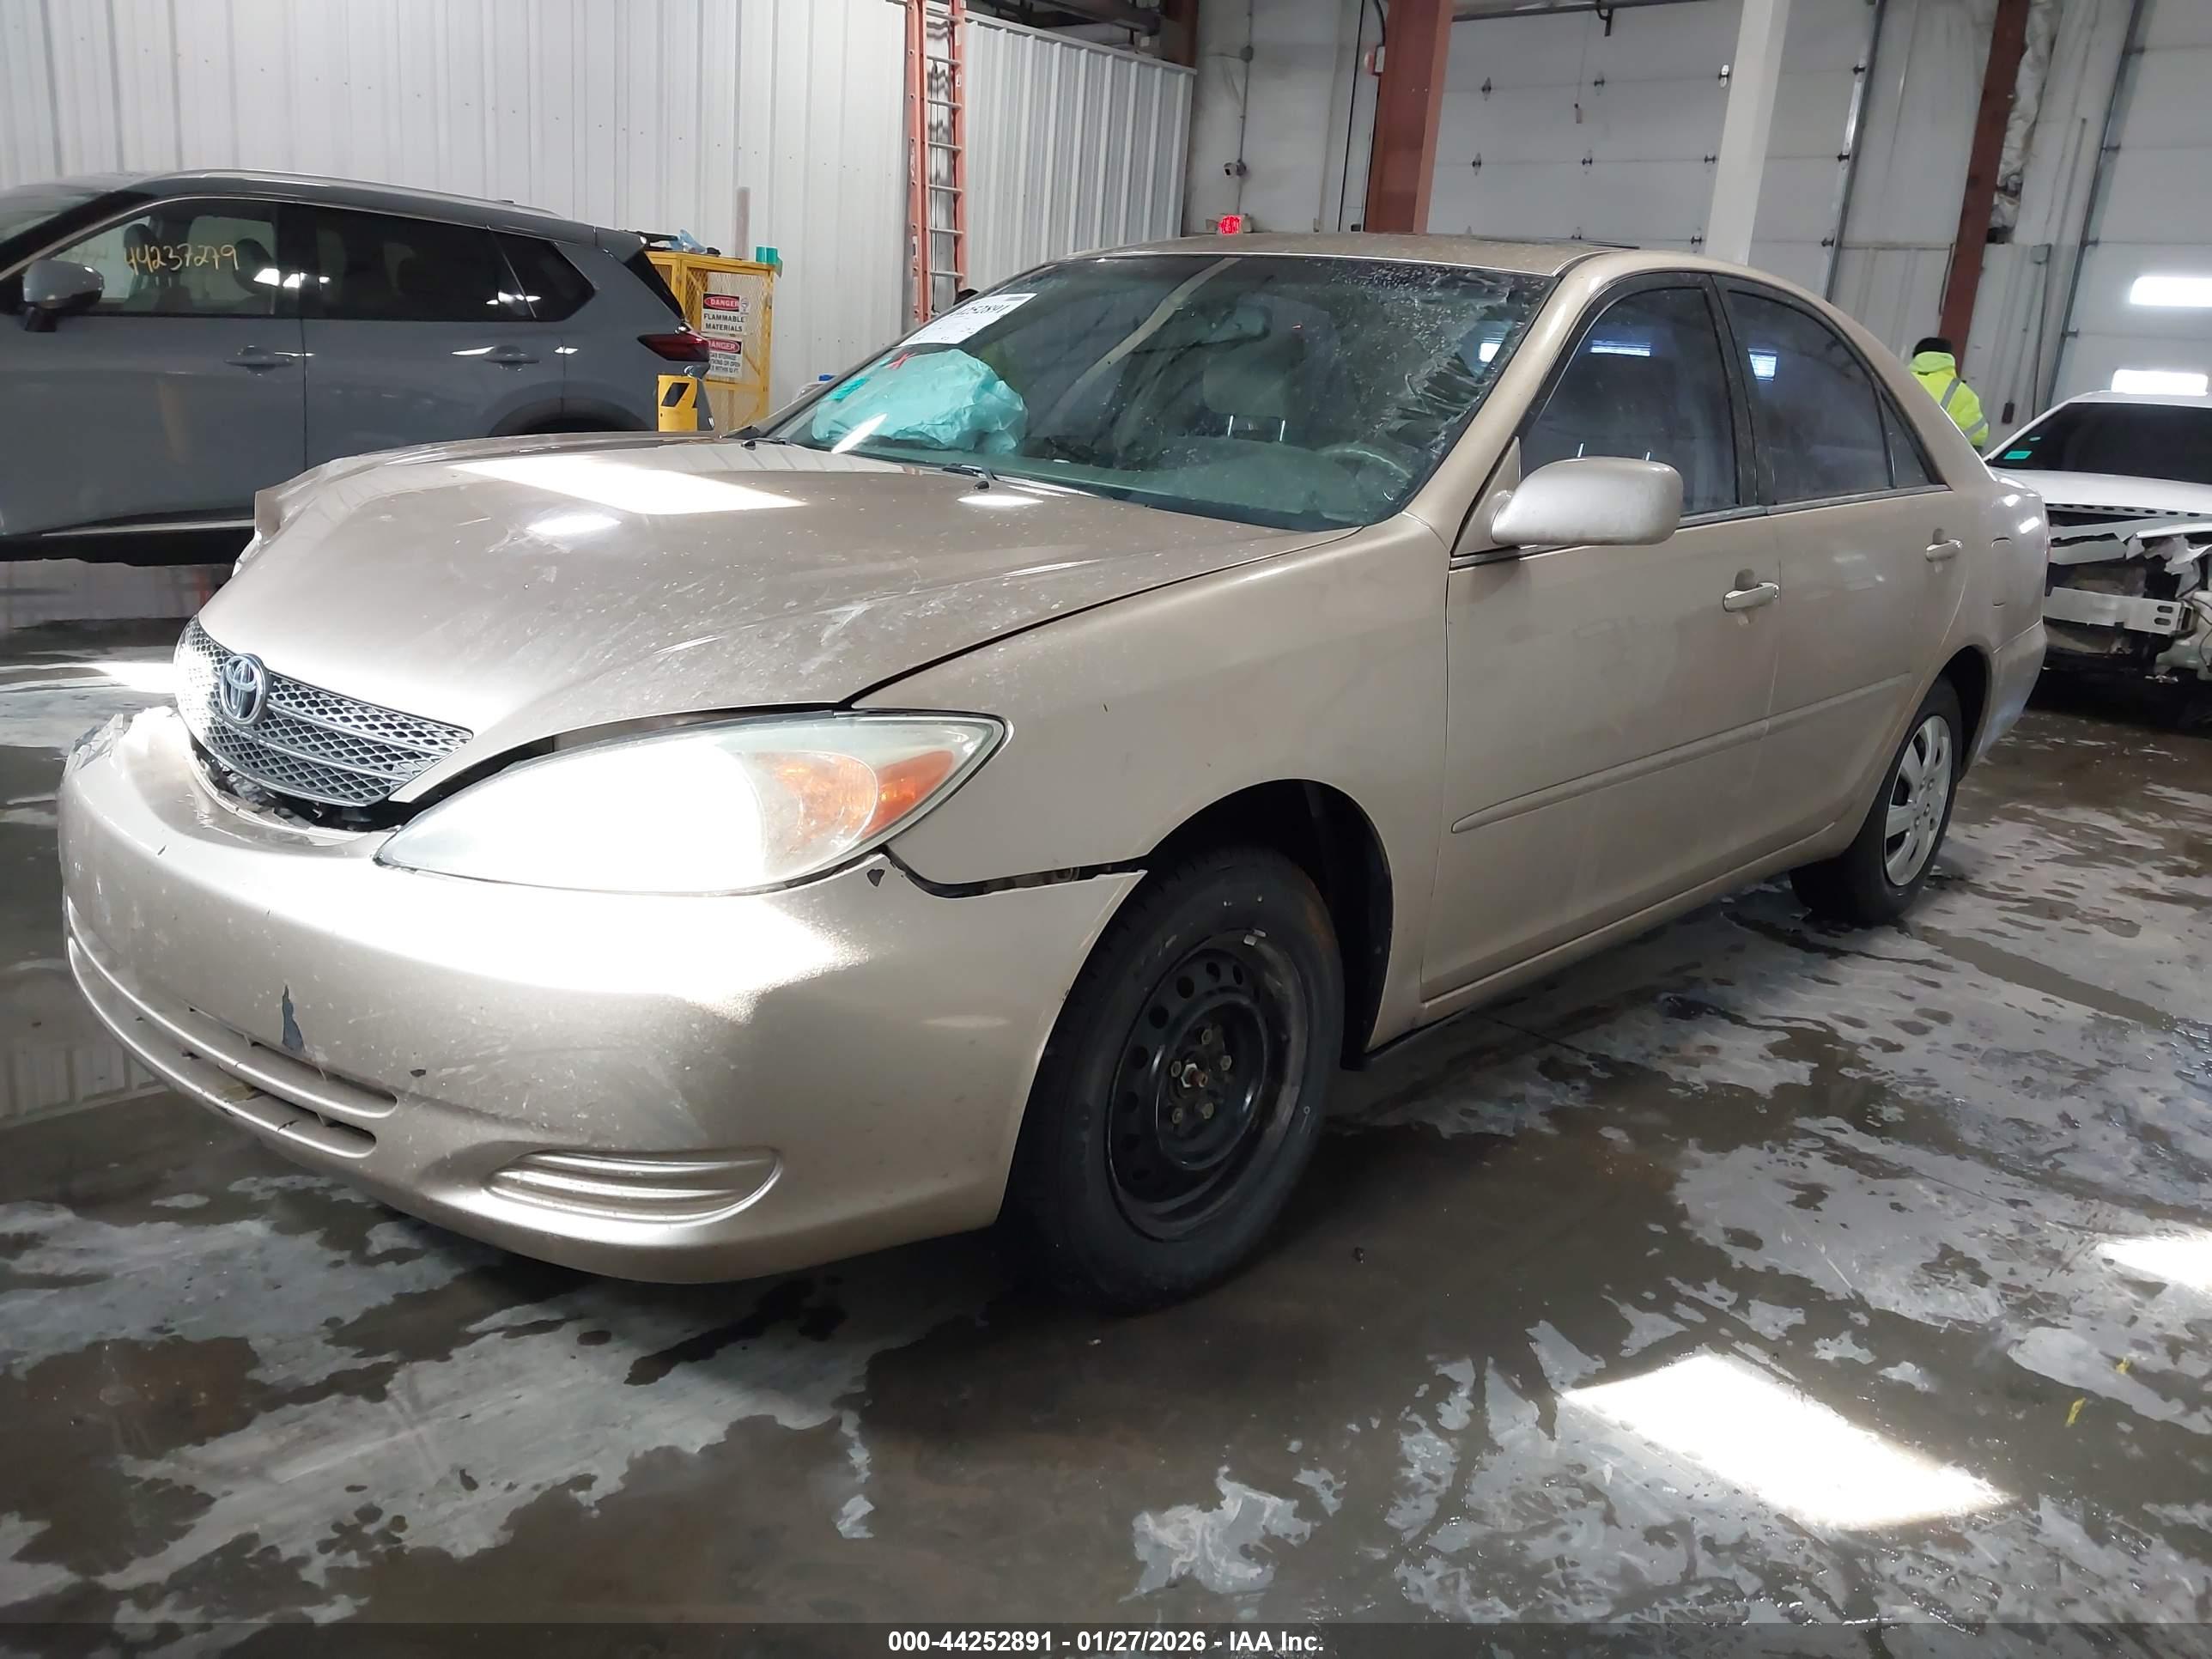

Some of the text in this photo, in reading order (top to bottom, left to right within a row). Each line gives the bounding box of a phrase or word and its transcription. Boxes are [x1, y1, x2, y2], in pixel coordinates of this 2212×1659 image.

[124, 243, 240, 275] 44237279
[710, 298, 738, 307] DANGER
[703, 313, 744, 323] FLAMMABLE
[705, 323, 743, 332] MATERIALS
